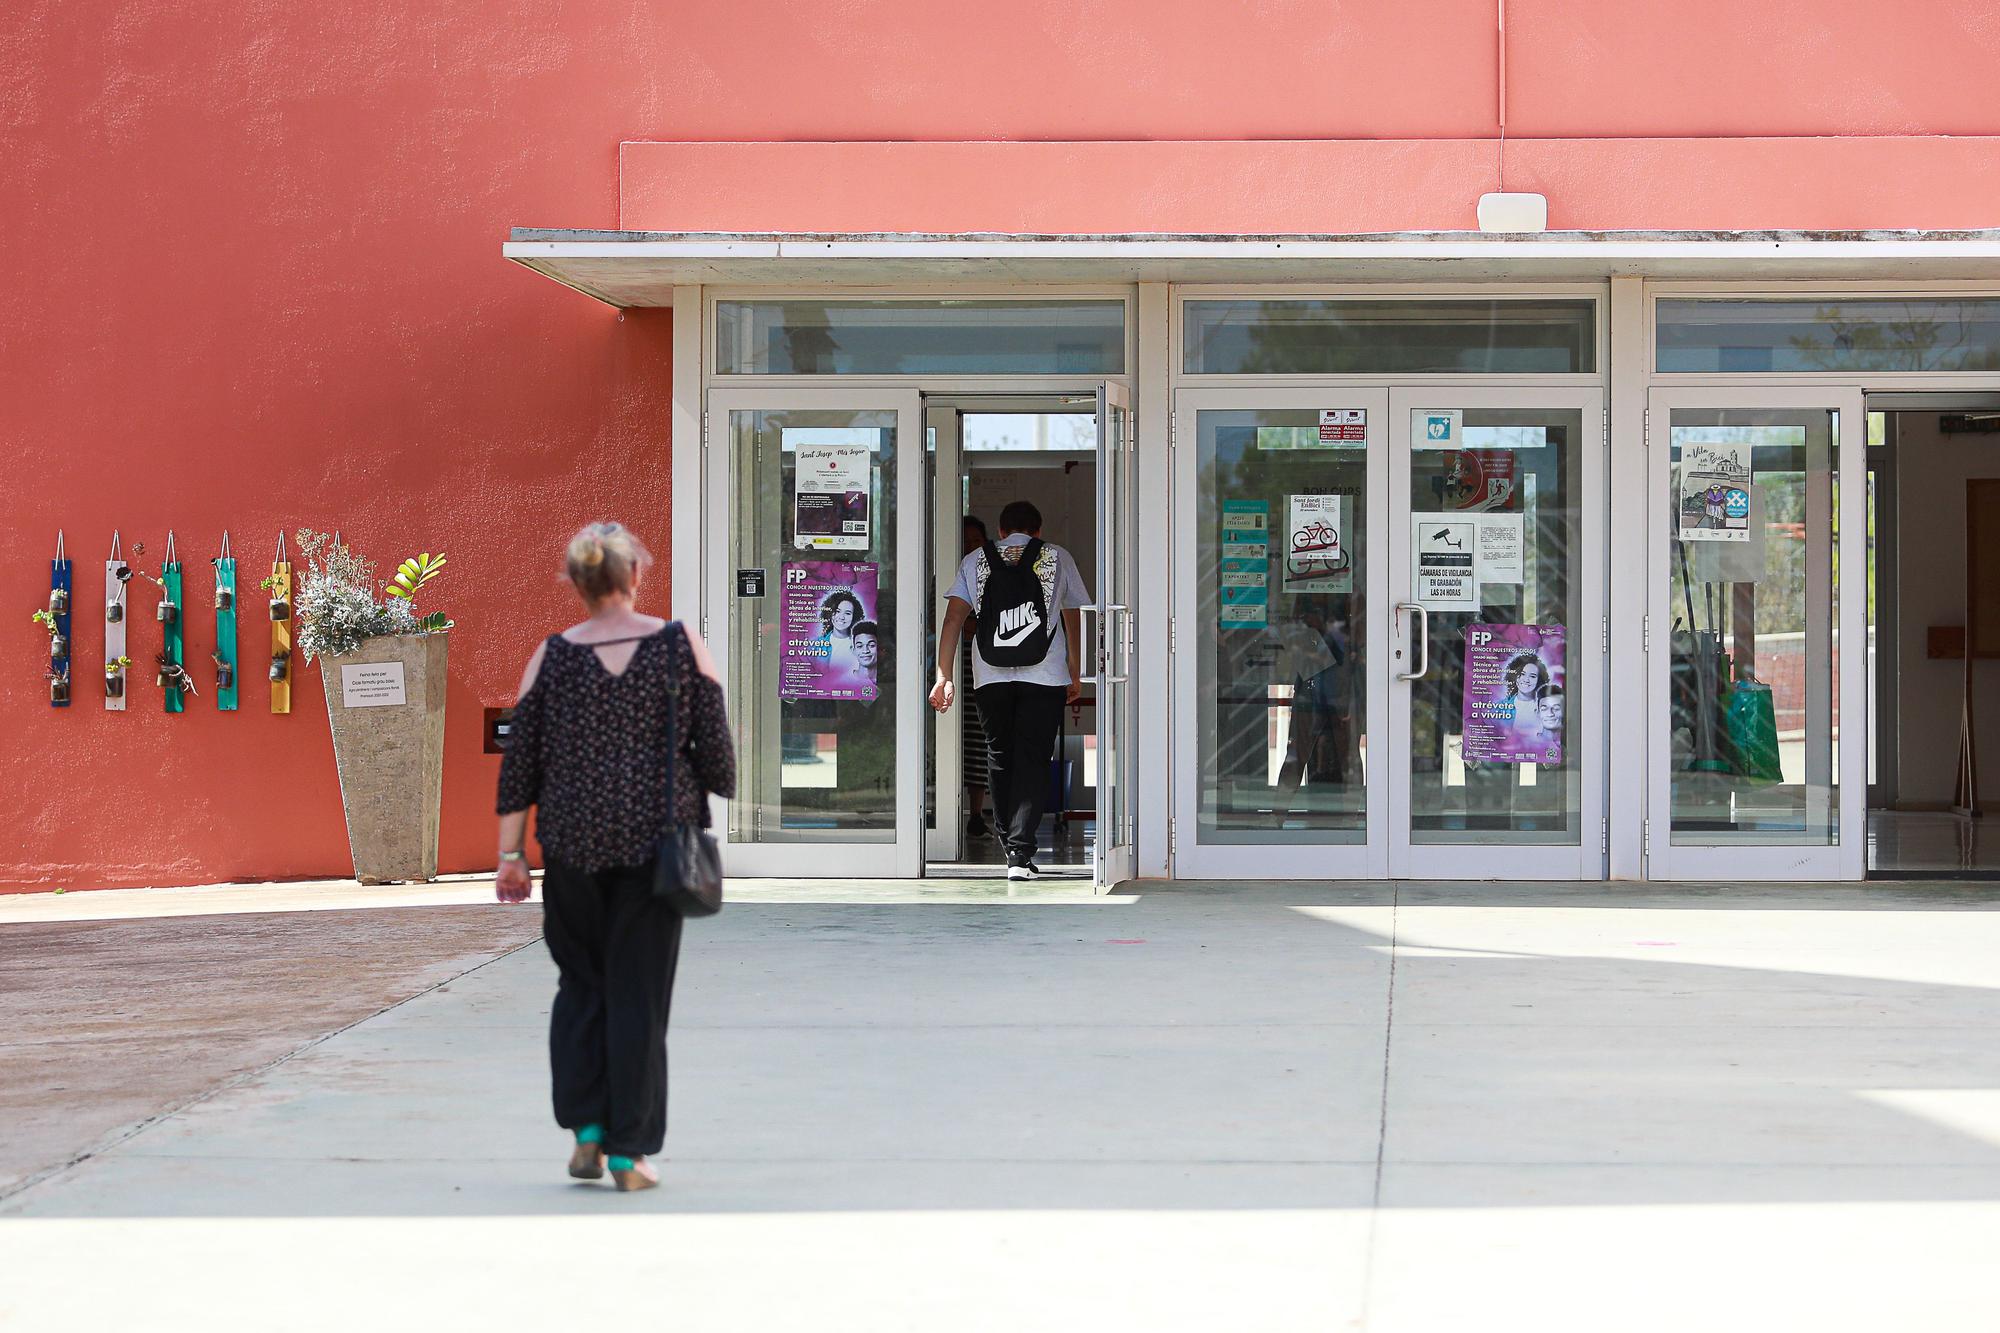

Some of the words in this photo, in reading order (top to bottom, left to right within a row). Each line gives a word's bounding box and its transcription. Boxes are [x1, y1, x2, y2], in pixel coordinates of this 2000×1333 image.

[786, 569, 807, 583] FP
[1420, 567, 1441, 577] CÁMARAS
[1442, 569, 1448, 577] DE
[1448, 569, 1472, 577] VIGILANCIA
[1437, 577, 1461, 586] GRABACIÓN
[1000, 601, 1040, 635] NIKE
[788, 638, 830, 647] atrévete
[1471, 631, 1492, 645] FP
[797, 648, 828, 656] vivirlo
[1472, 701, 1514, 710] atrévete
[1481, 710, 1512, 719] vivirlo
